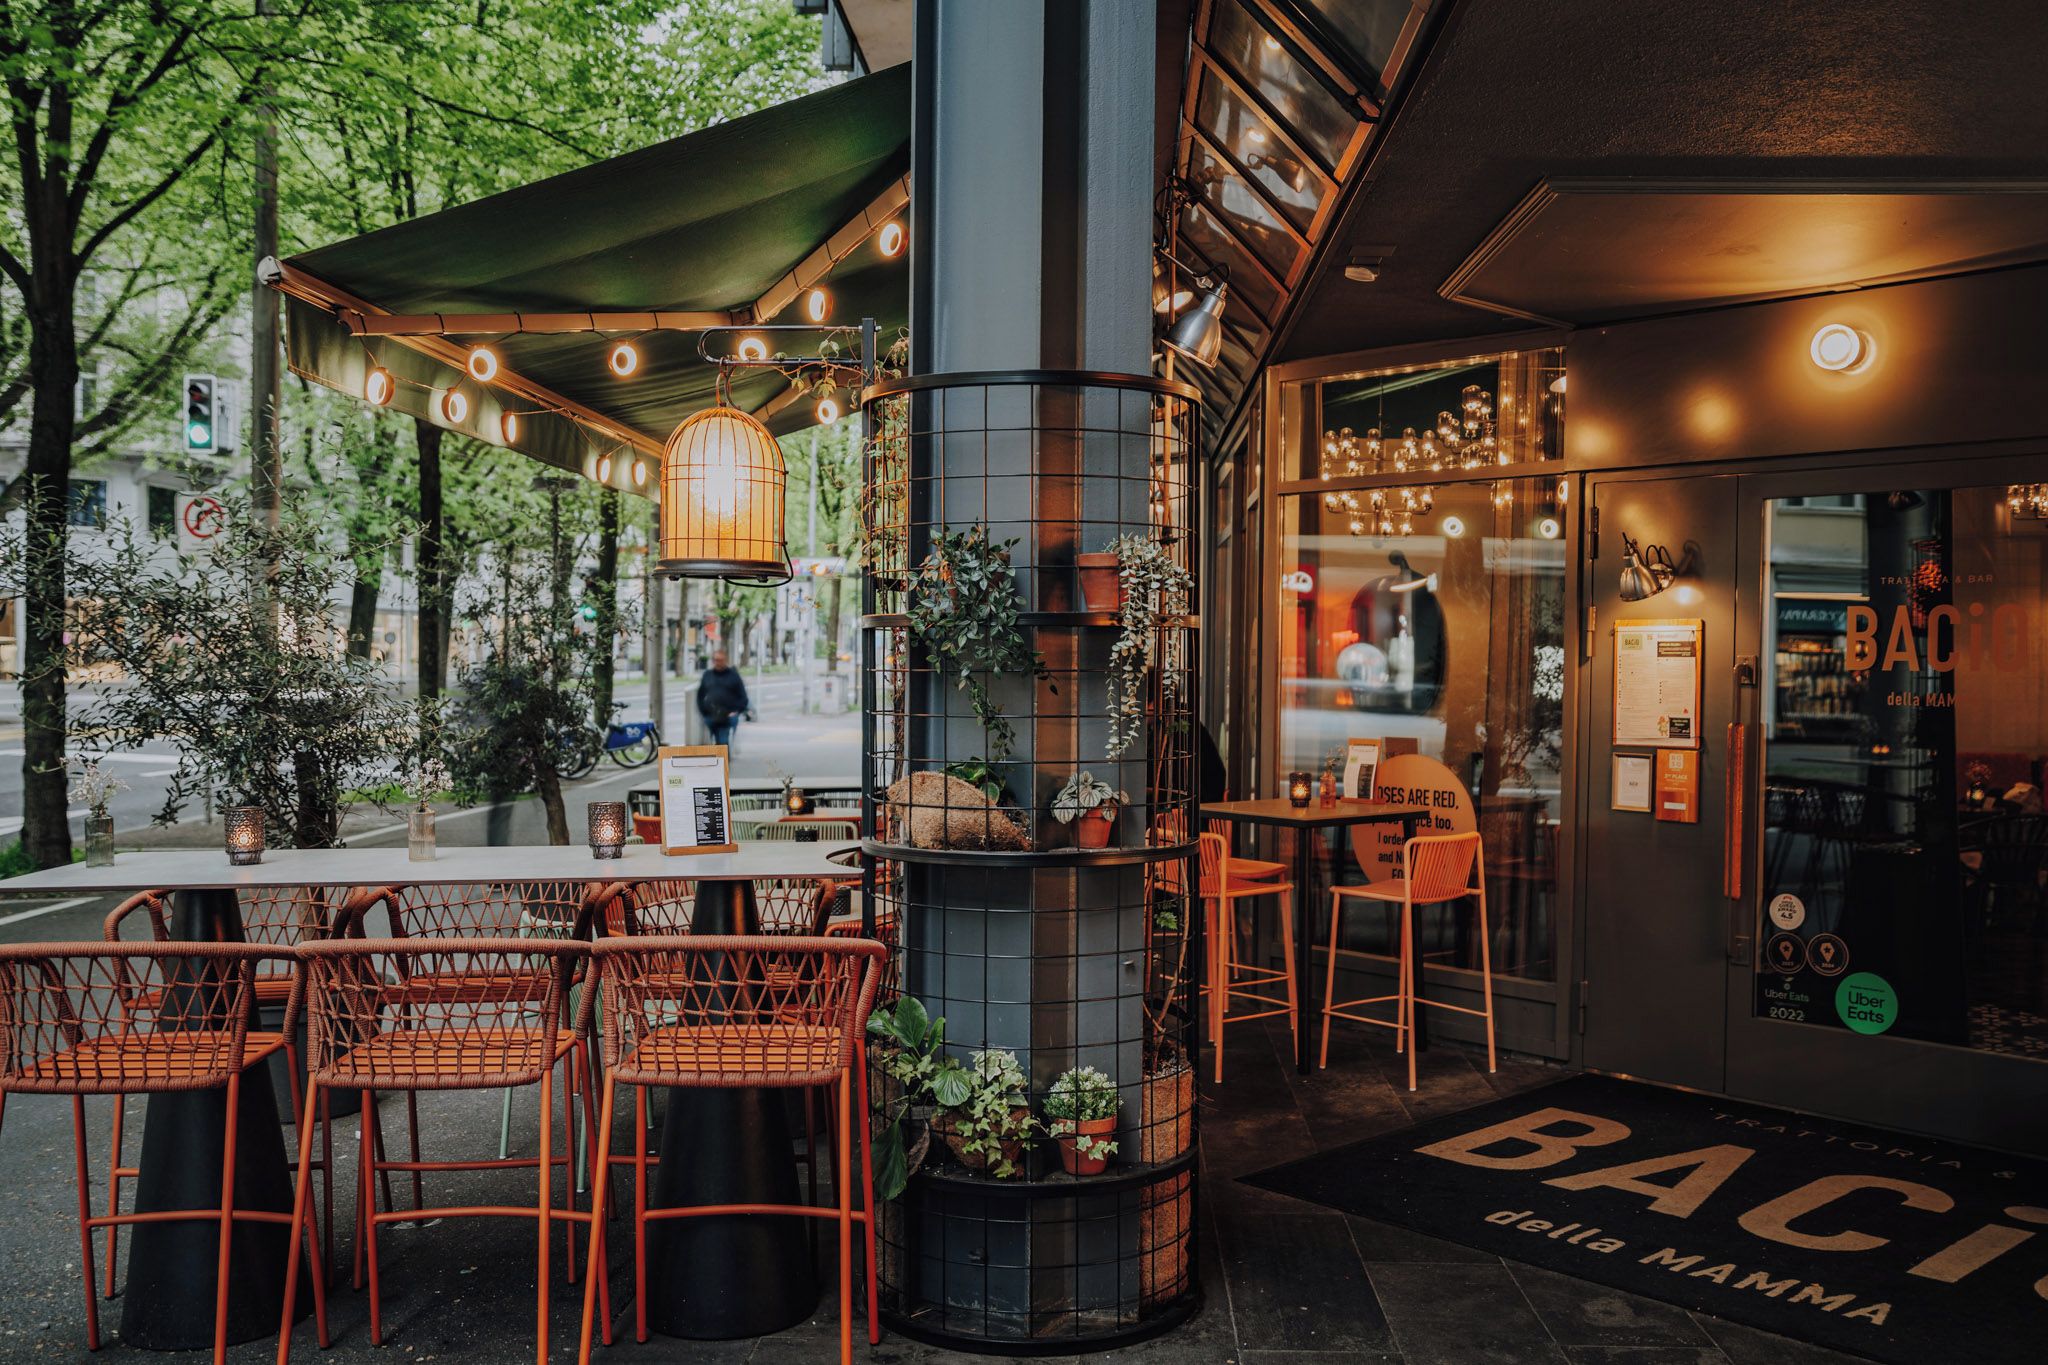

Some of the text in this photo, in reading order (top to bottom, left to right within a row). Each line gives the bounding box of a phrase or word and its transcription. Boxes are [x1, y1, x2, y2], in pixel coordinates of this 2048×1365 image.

[1968, 574, 1993, 584] BAR
[1845, 602, 2028, 673] BACiO
[1887, 692, 1957, 708] della MAM
[1378, 786, 1459, 810] OSES ARE RED,
[1435, 815, 1454, 831] too,
[1378, 851, 1394, 864] and
[1764, 988, 1810, 1003] Uber Eats
[1848, 990, 1886, 1009] Uber
[1769, 1006, 1806, 1022] 2022
[1847, 1005, 1885, 1024] Eats
[1713, 1112, 1962, 1169] TRATTORIA
[1413, 1106, 2048, 1302] BACi
[1483, 1209, 1892, 1326] della MAMMA
